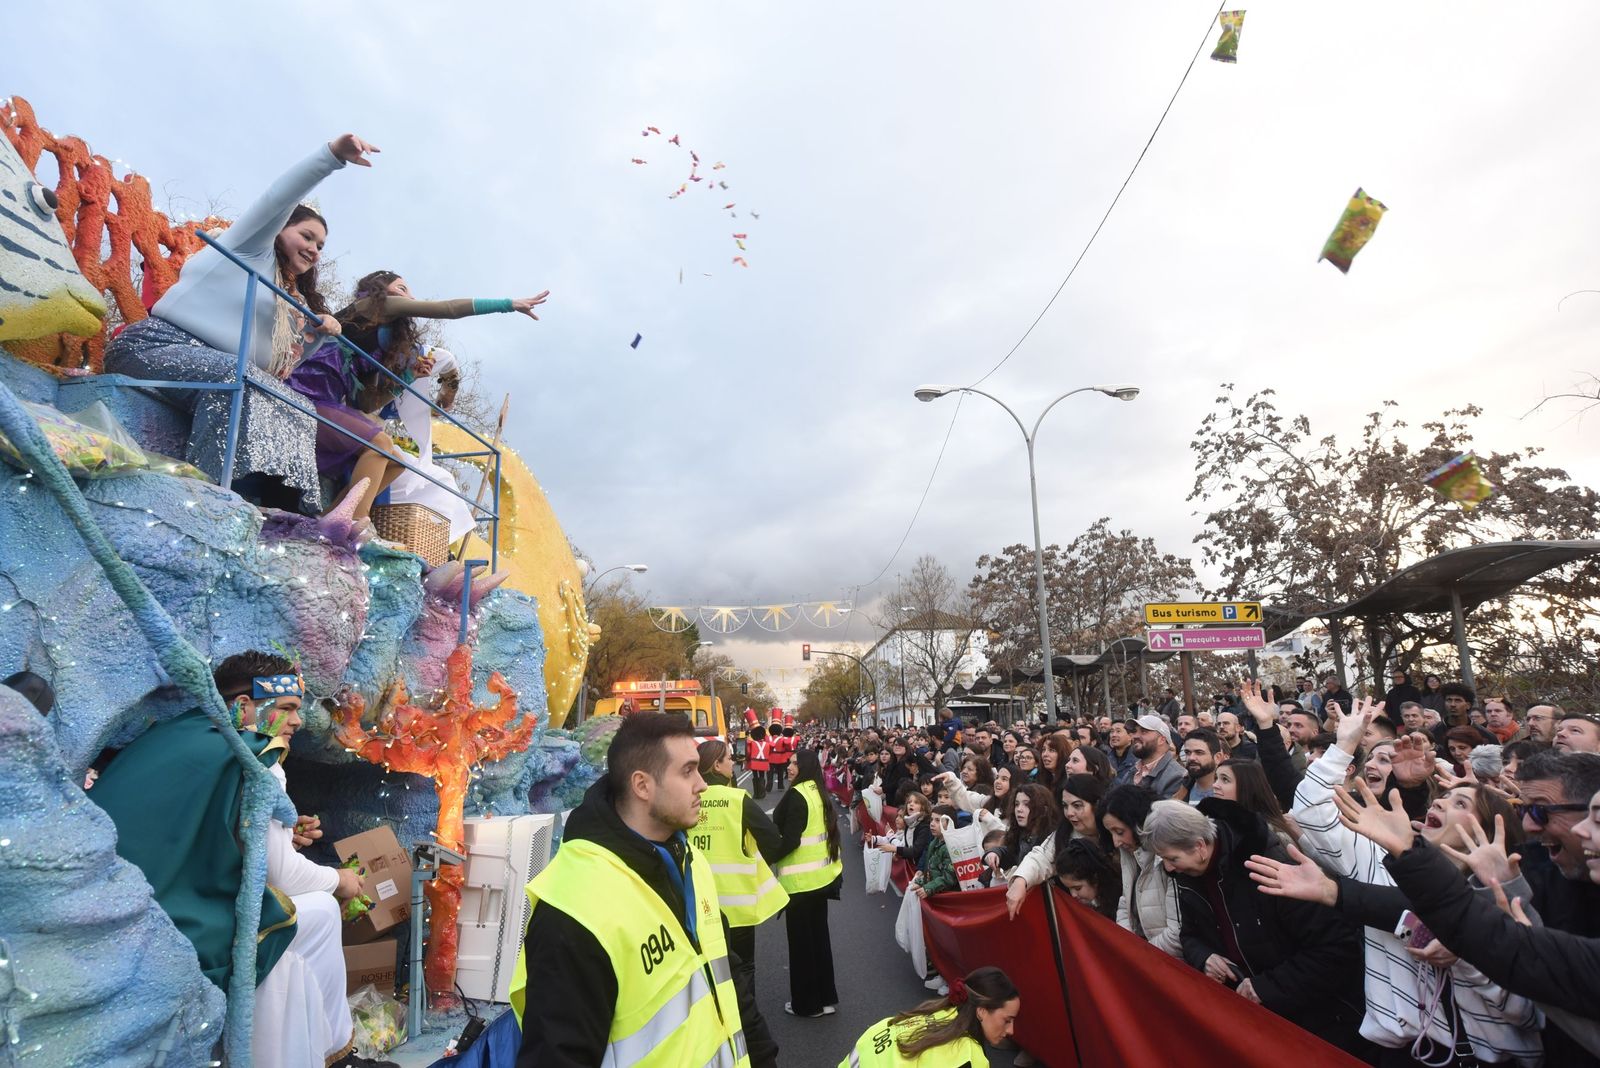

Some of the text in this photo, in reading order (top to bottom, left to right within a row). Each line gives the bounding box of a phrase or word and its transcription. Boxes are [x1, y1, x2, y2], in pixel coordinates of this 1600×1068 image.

[1152, 606, 1234, 619] Bus turismo P
[1185, 635, 1220, 644] mezquita
[1228, 634, 1260, 642] catedral
[700, 797, 729, 808] IZACIÓN
[693, 834, 711, 851] 091
[640, 923, 676, 975] 094
[872, 1027, 893, 1055] 096
